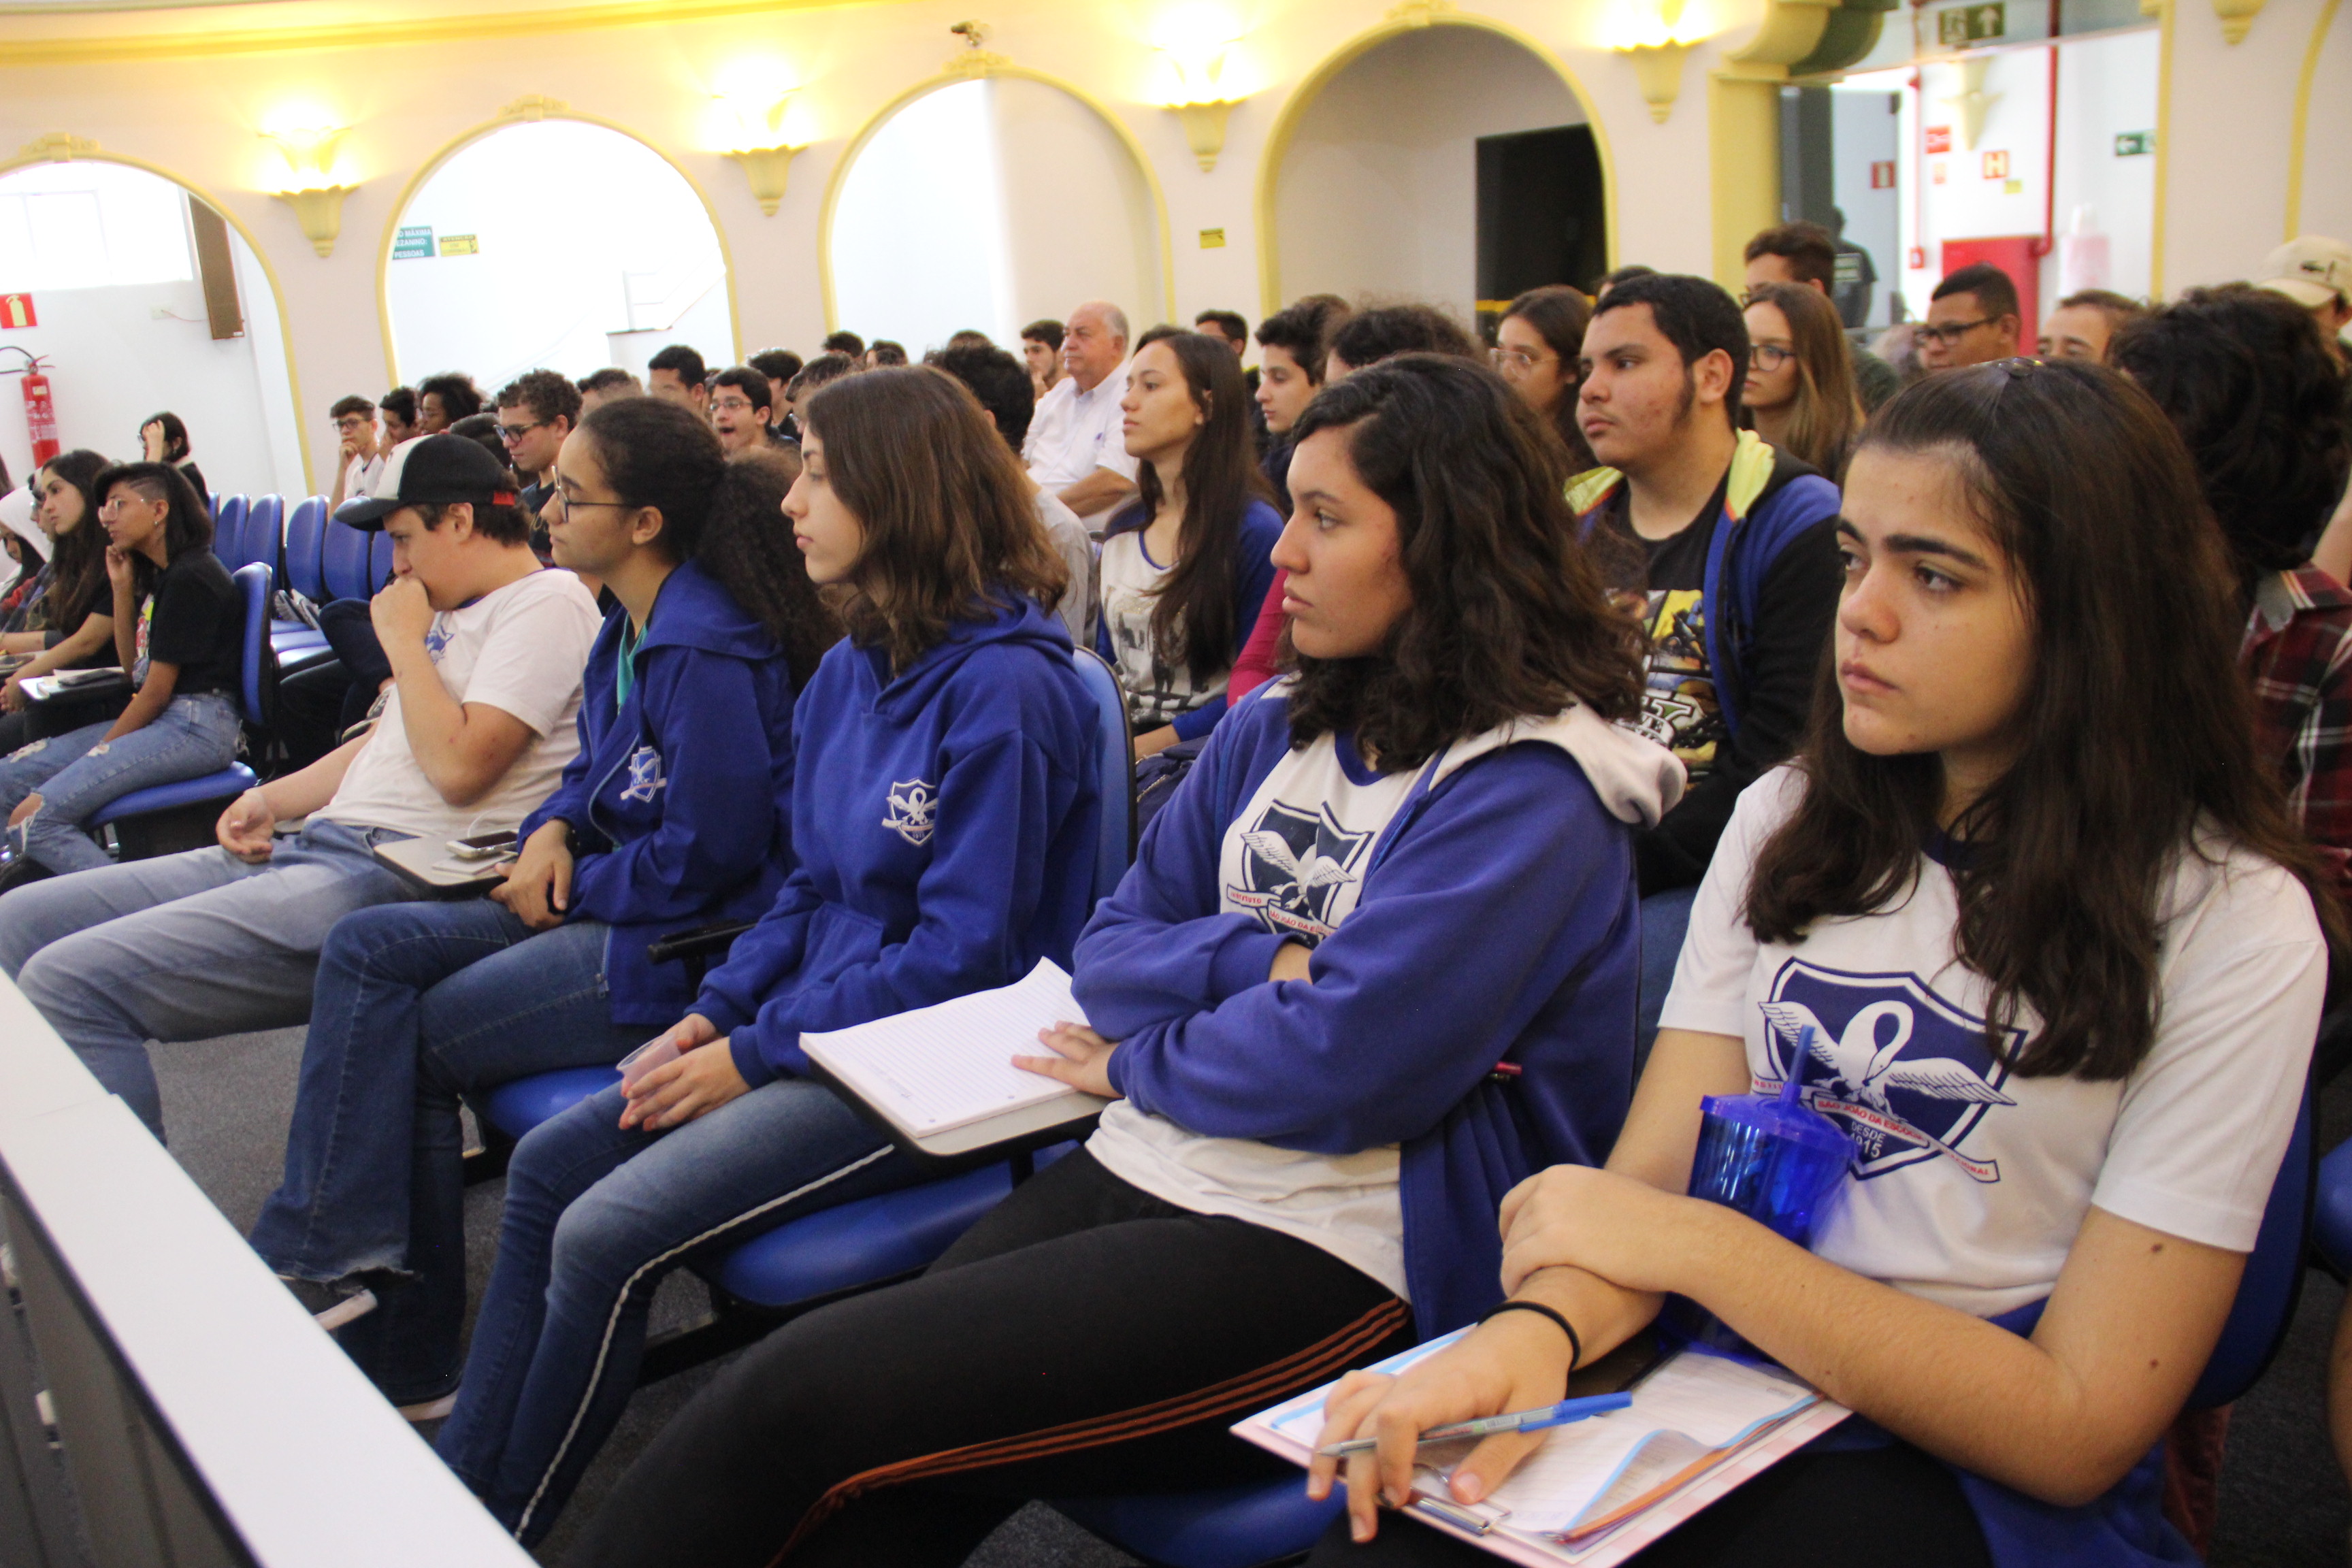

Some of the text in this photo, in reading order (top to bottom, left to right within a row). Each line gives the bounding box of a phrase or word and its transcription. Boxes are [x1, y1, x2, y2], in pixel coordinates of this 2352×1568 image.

[397, 237, 427, 246] EZANINO:
[394, 249, 425, 258] PESSOAS
[1298, 921, 1309, 930] DA
[1868, 1114, 1882, 1125] DA
[1851, 1122, 1886, 1143] DESDE
